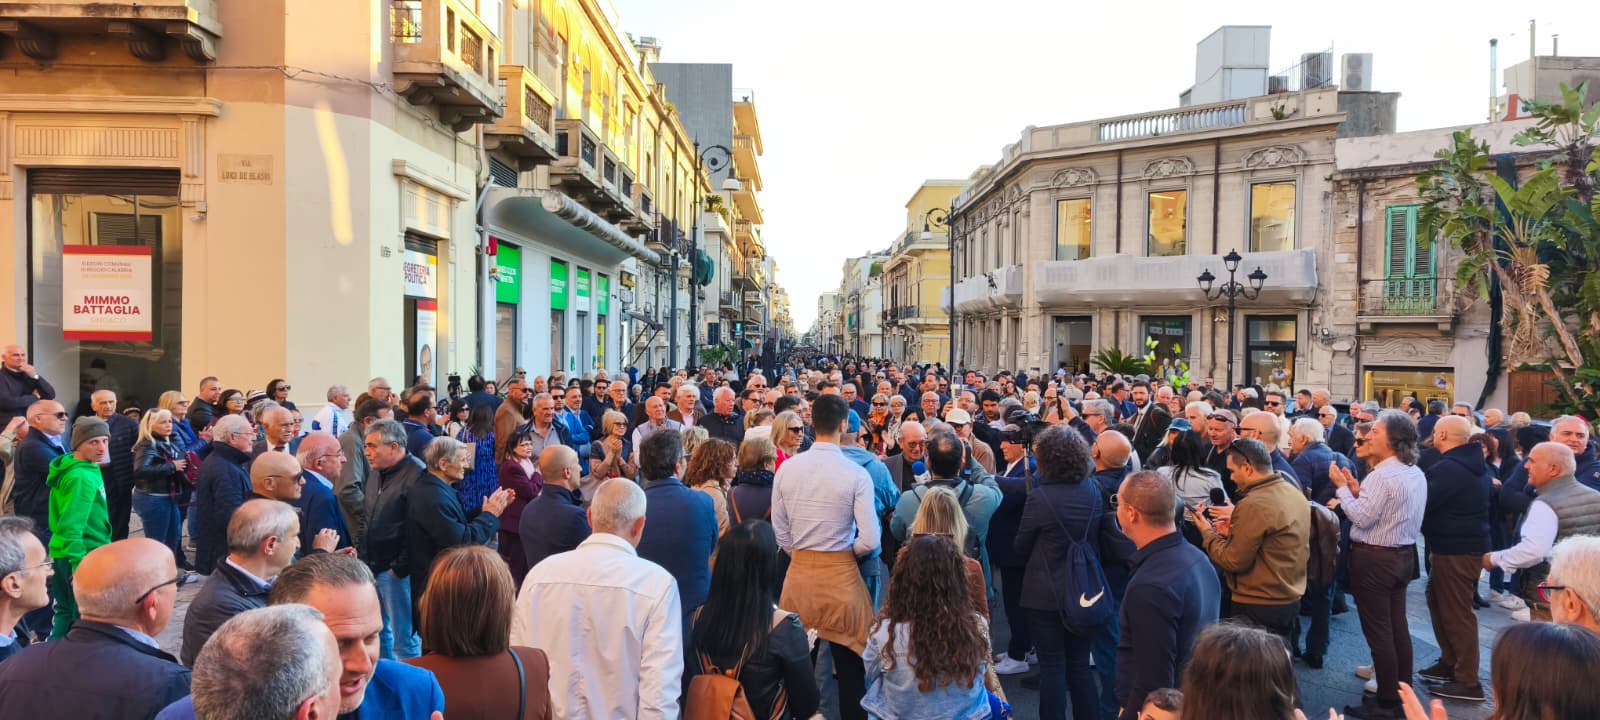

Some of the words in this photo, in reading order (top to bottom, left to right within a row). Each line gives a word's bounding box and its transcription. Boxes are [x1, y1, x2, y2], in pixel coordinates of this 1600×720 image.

[403, 262, 430, 276] EGRETERIA
[404, 272, 427, 284] POLITICA
[84, 296, 130, 304] MIMMO
[73, 305, 140, 314] BATTAGLIA
